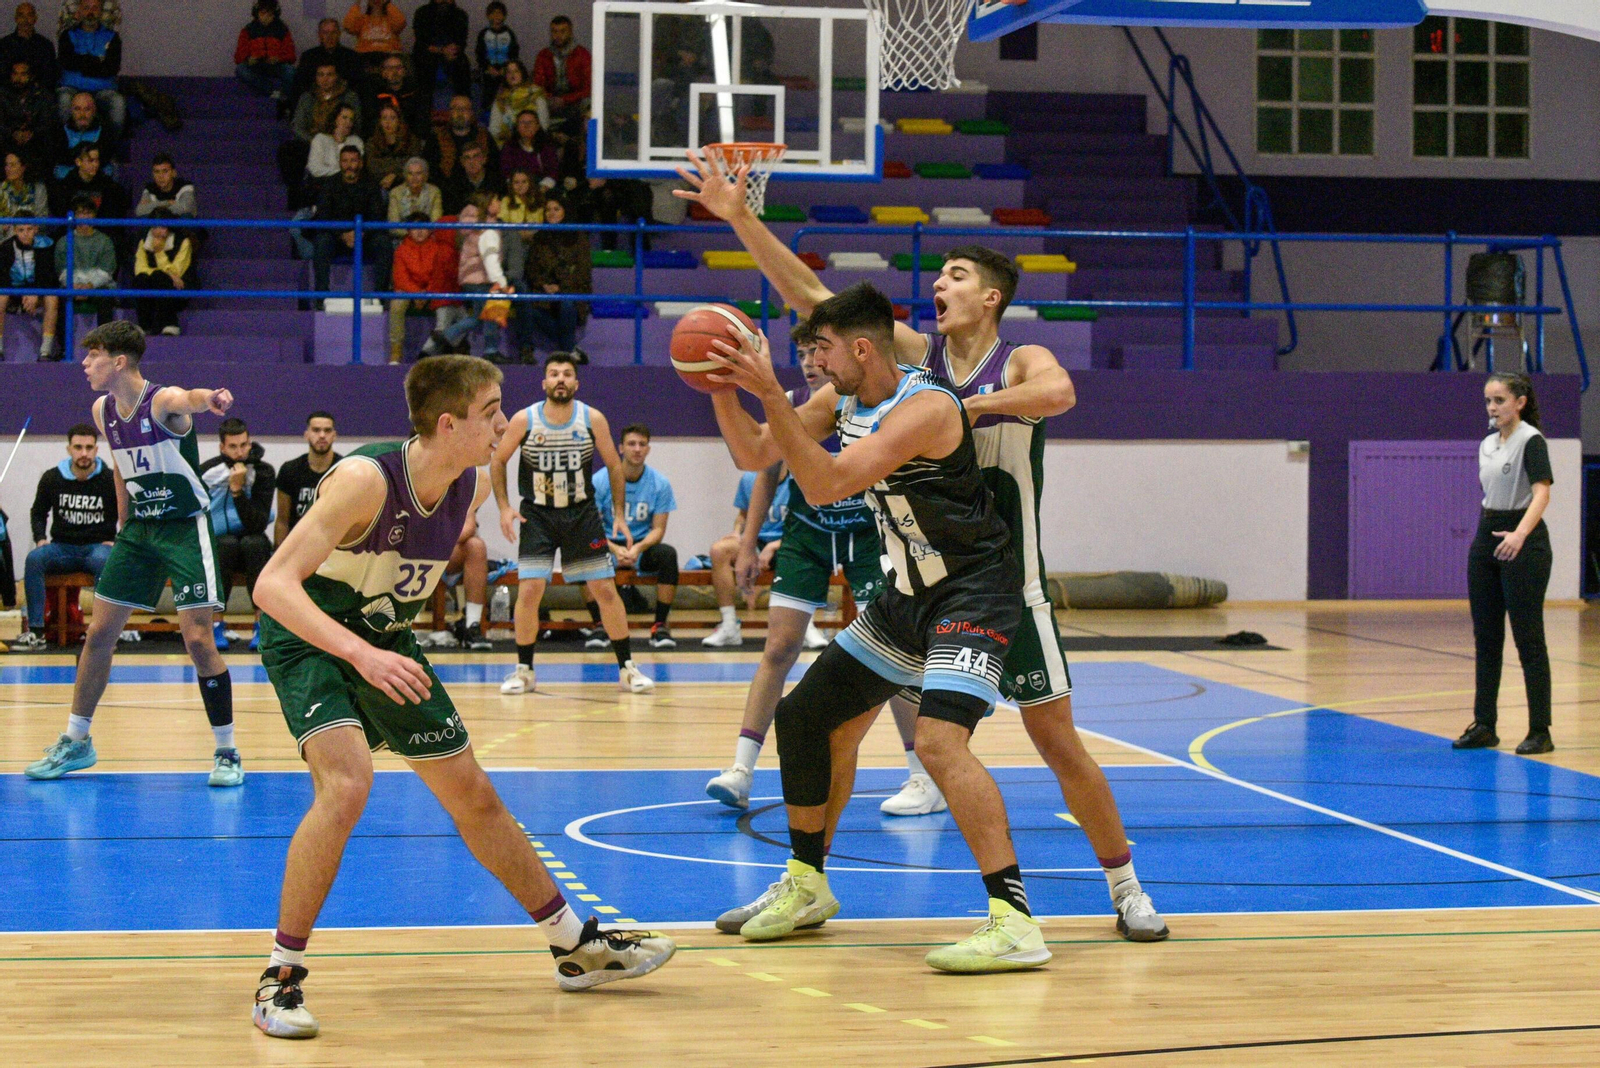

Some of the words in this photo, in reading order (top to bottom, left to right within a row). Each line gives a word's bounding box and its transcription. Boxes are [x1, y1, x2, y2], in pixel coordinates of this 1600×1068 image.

[127, 449, 150, 473] 14
[539, 450, 582, 470] ULB
[394, 564, 433, 597] 23
[962, 621, 985, 635] Ruiz
[953, 646, 989, 678] 44
